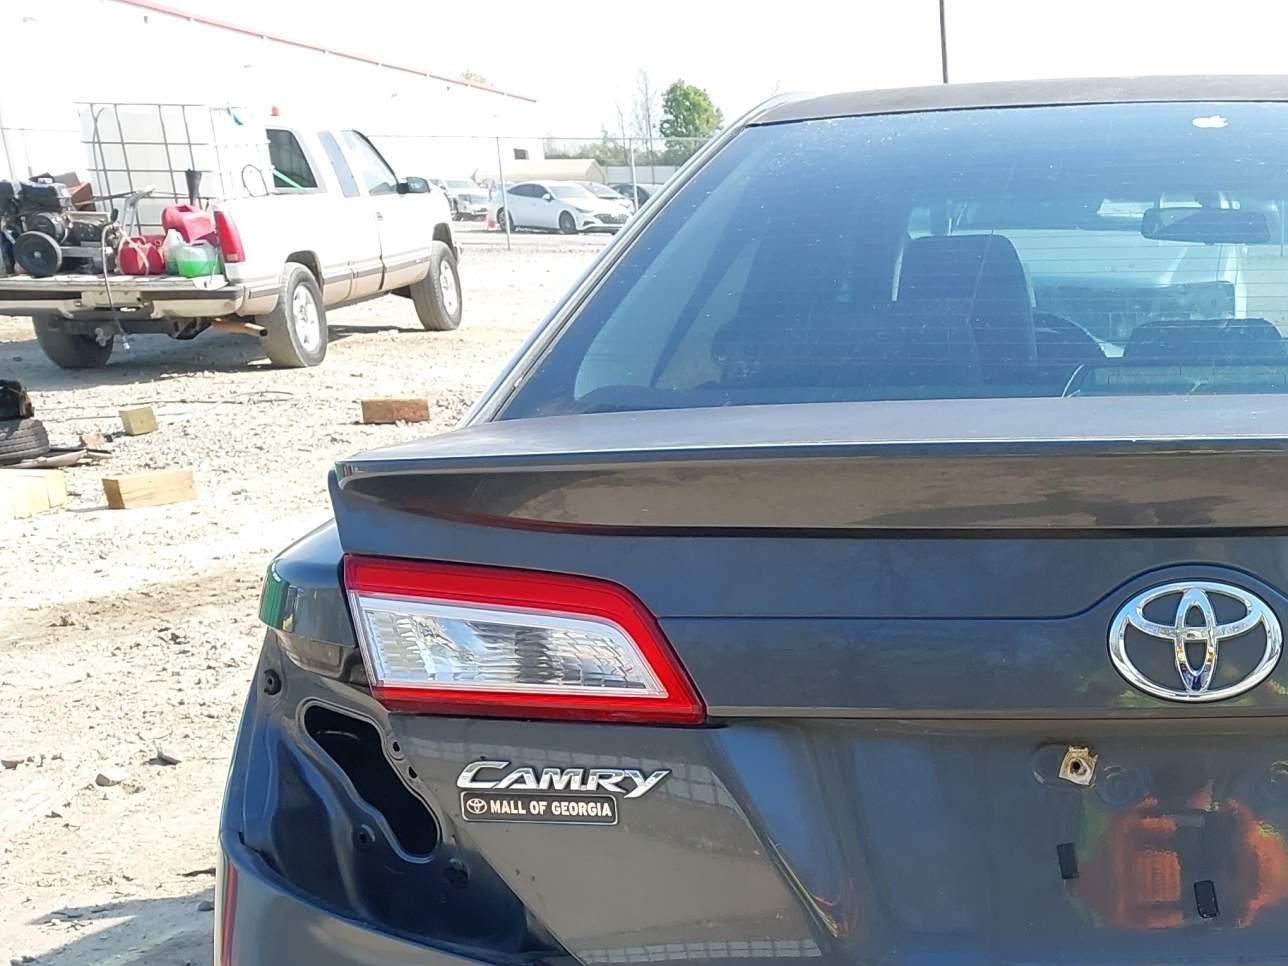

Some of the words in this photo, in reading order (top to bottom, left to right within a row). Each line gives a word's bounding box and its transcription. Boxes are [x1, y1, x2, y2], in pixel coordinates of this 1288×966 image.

[456, 760, 672, 799] CAMRY
[489, 800, 527, 815] MALL
[530, 801, 548, 816] OF
[551, 801, 613, 817] GEORGIA
